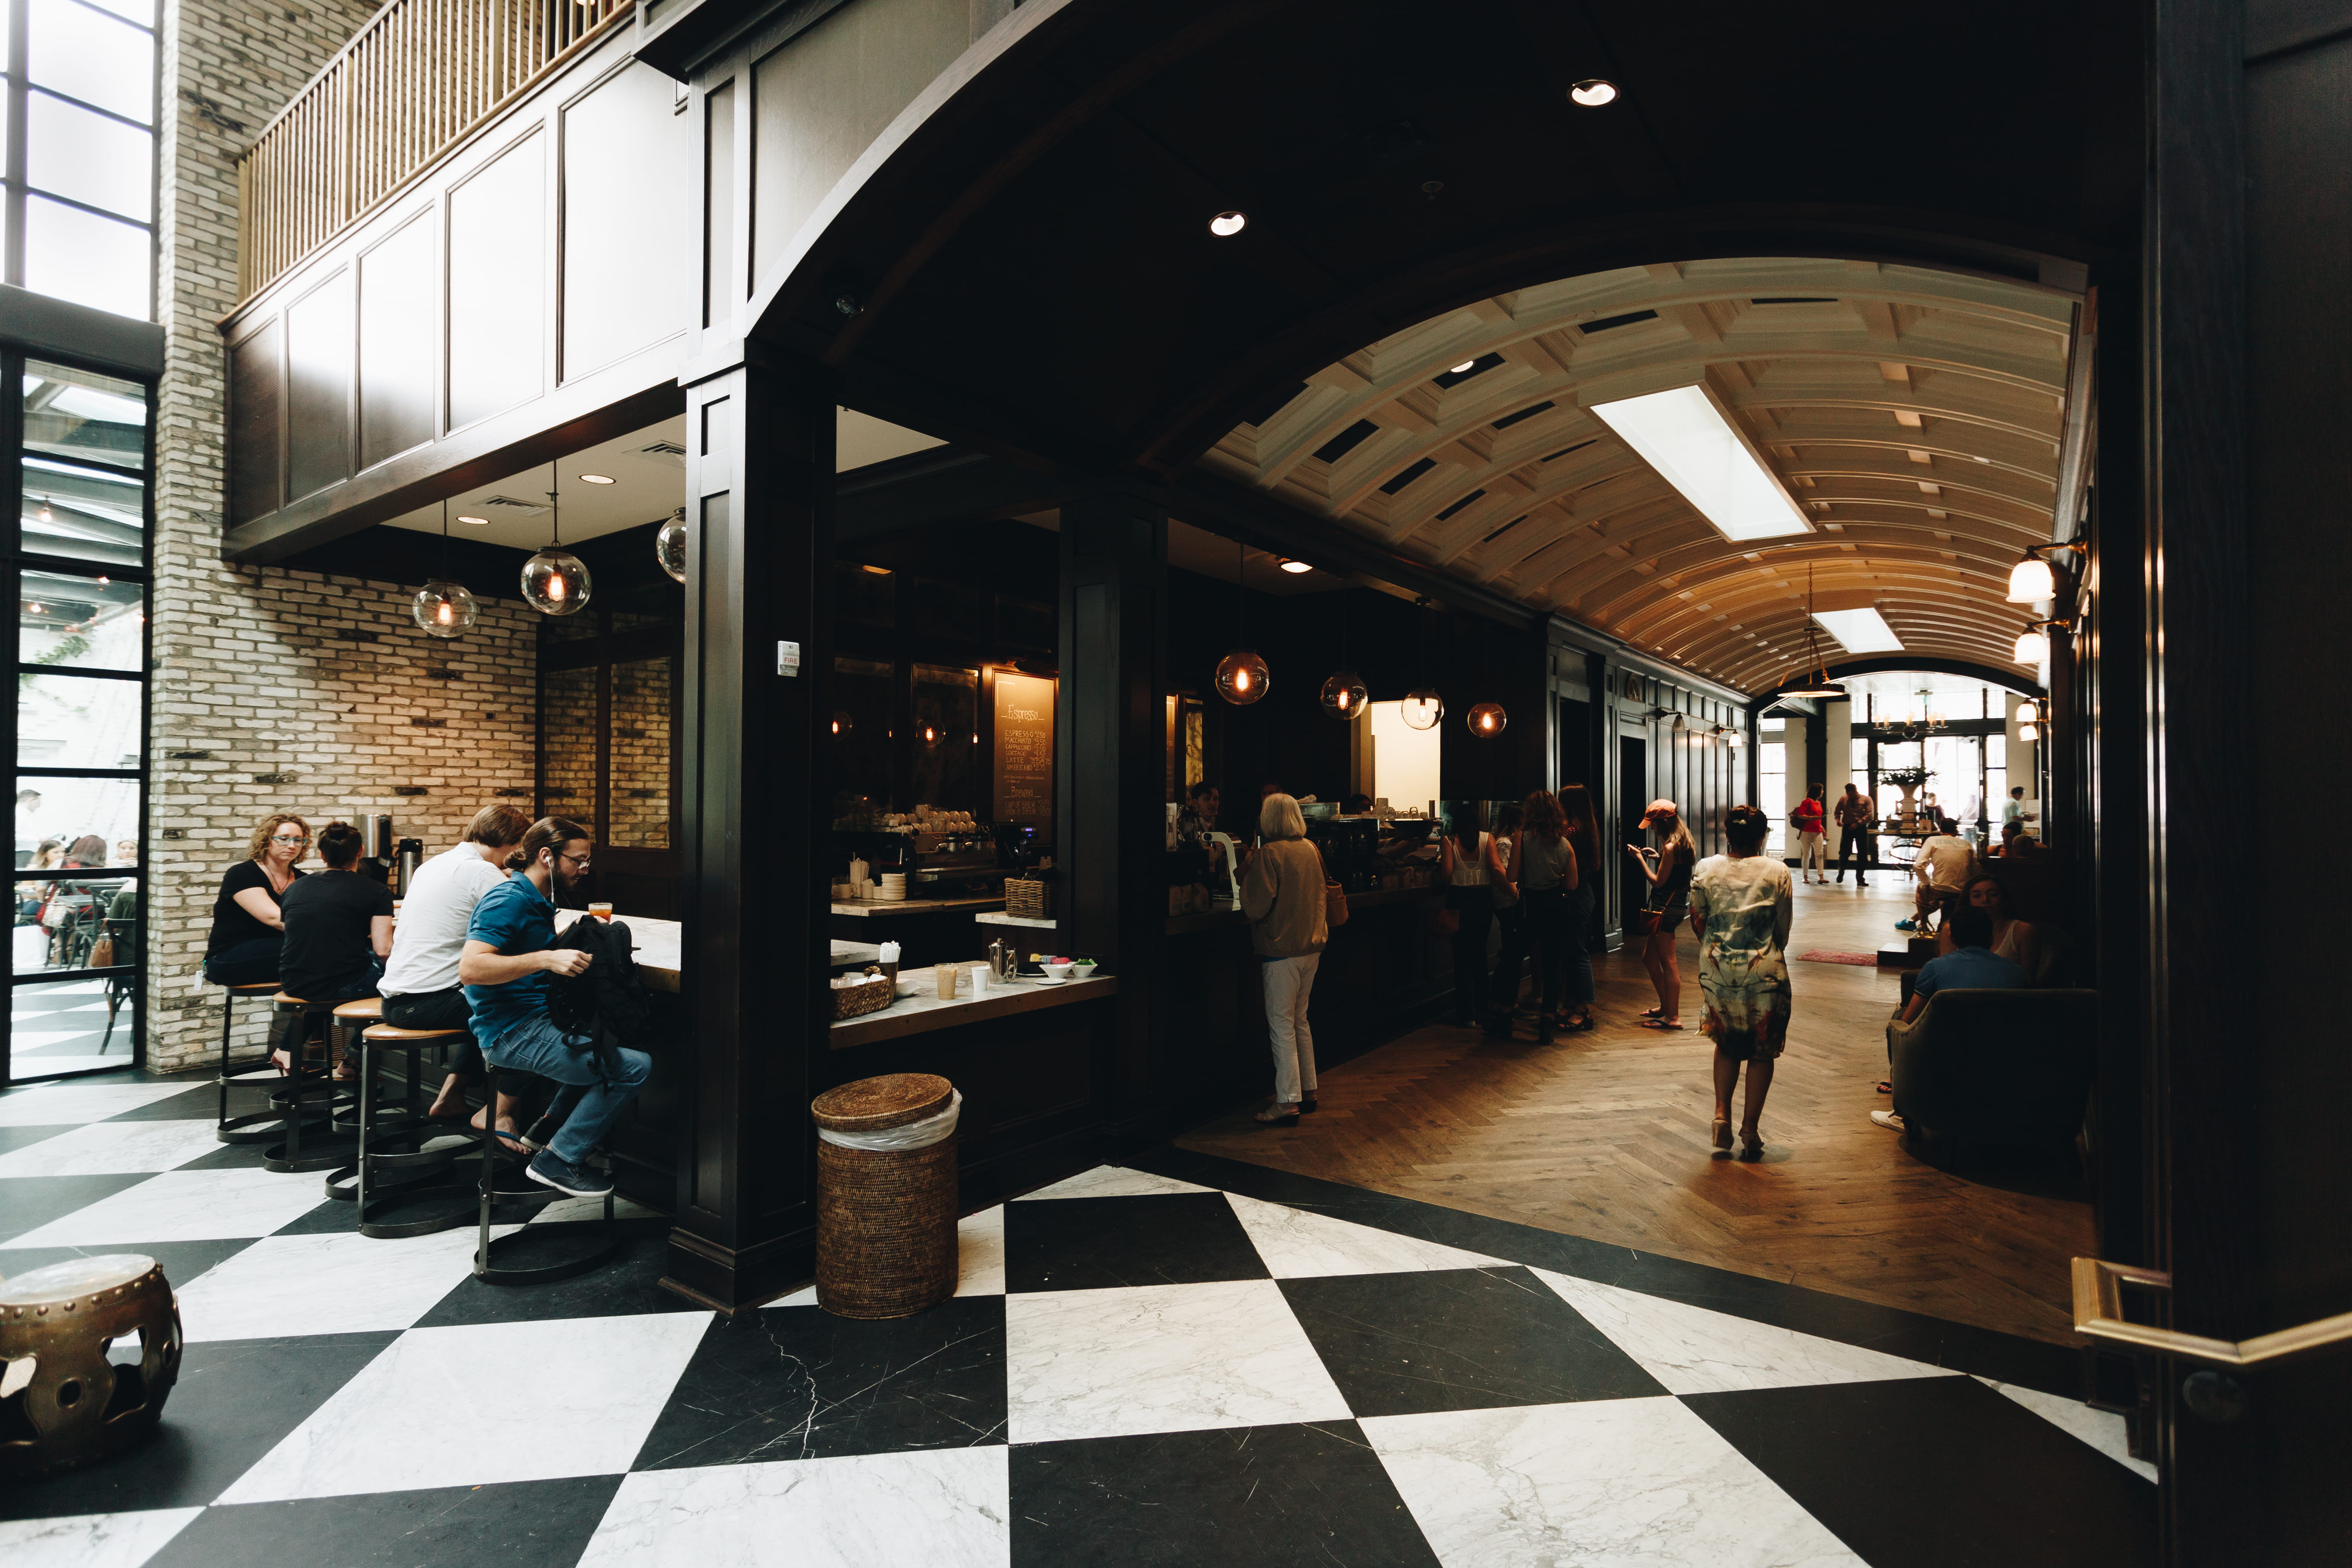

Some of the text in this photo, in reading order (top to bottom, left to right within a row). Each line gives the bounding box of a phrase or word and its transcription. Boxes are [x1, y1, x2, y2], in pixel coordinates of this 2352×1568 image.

[1007, 704, 1038, 723] Espresso
[1006, 763, 1032, 771] AMERICANO
[1011, 785, 1033, 797] Brewed
[1022, 800, 1035, 808] BREW
[1022, 807, 1036, 815] BREW
